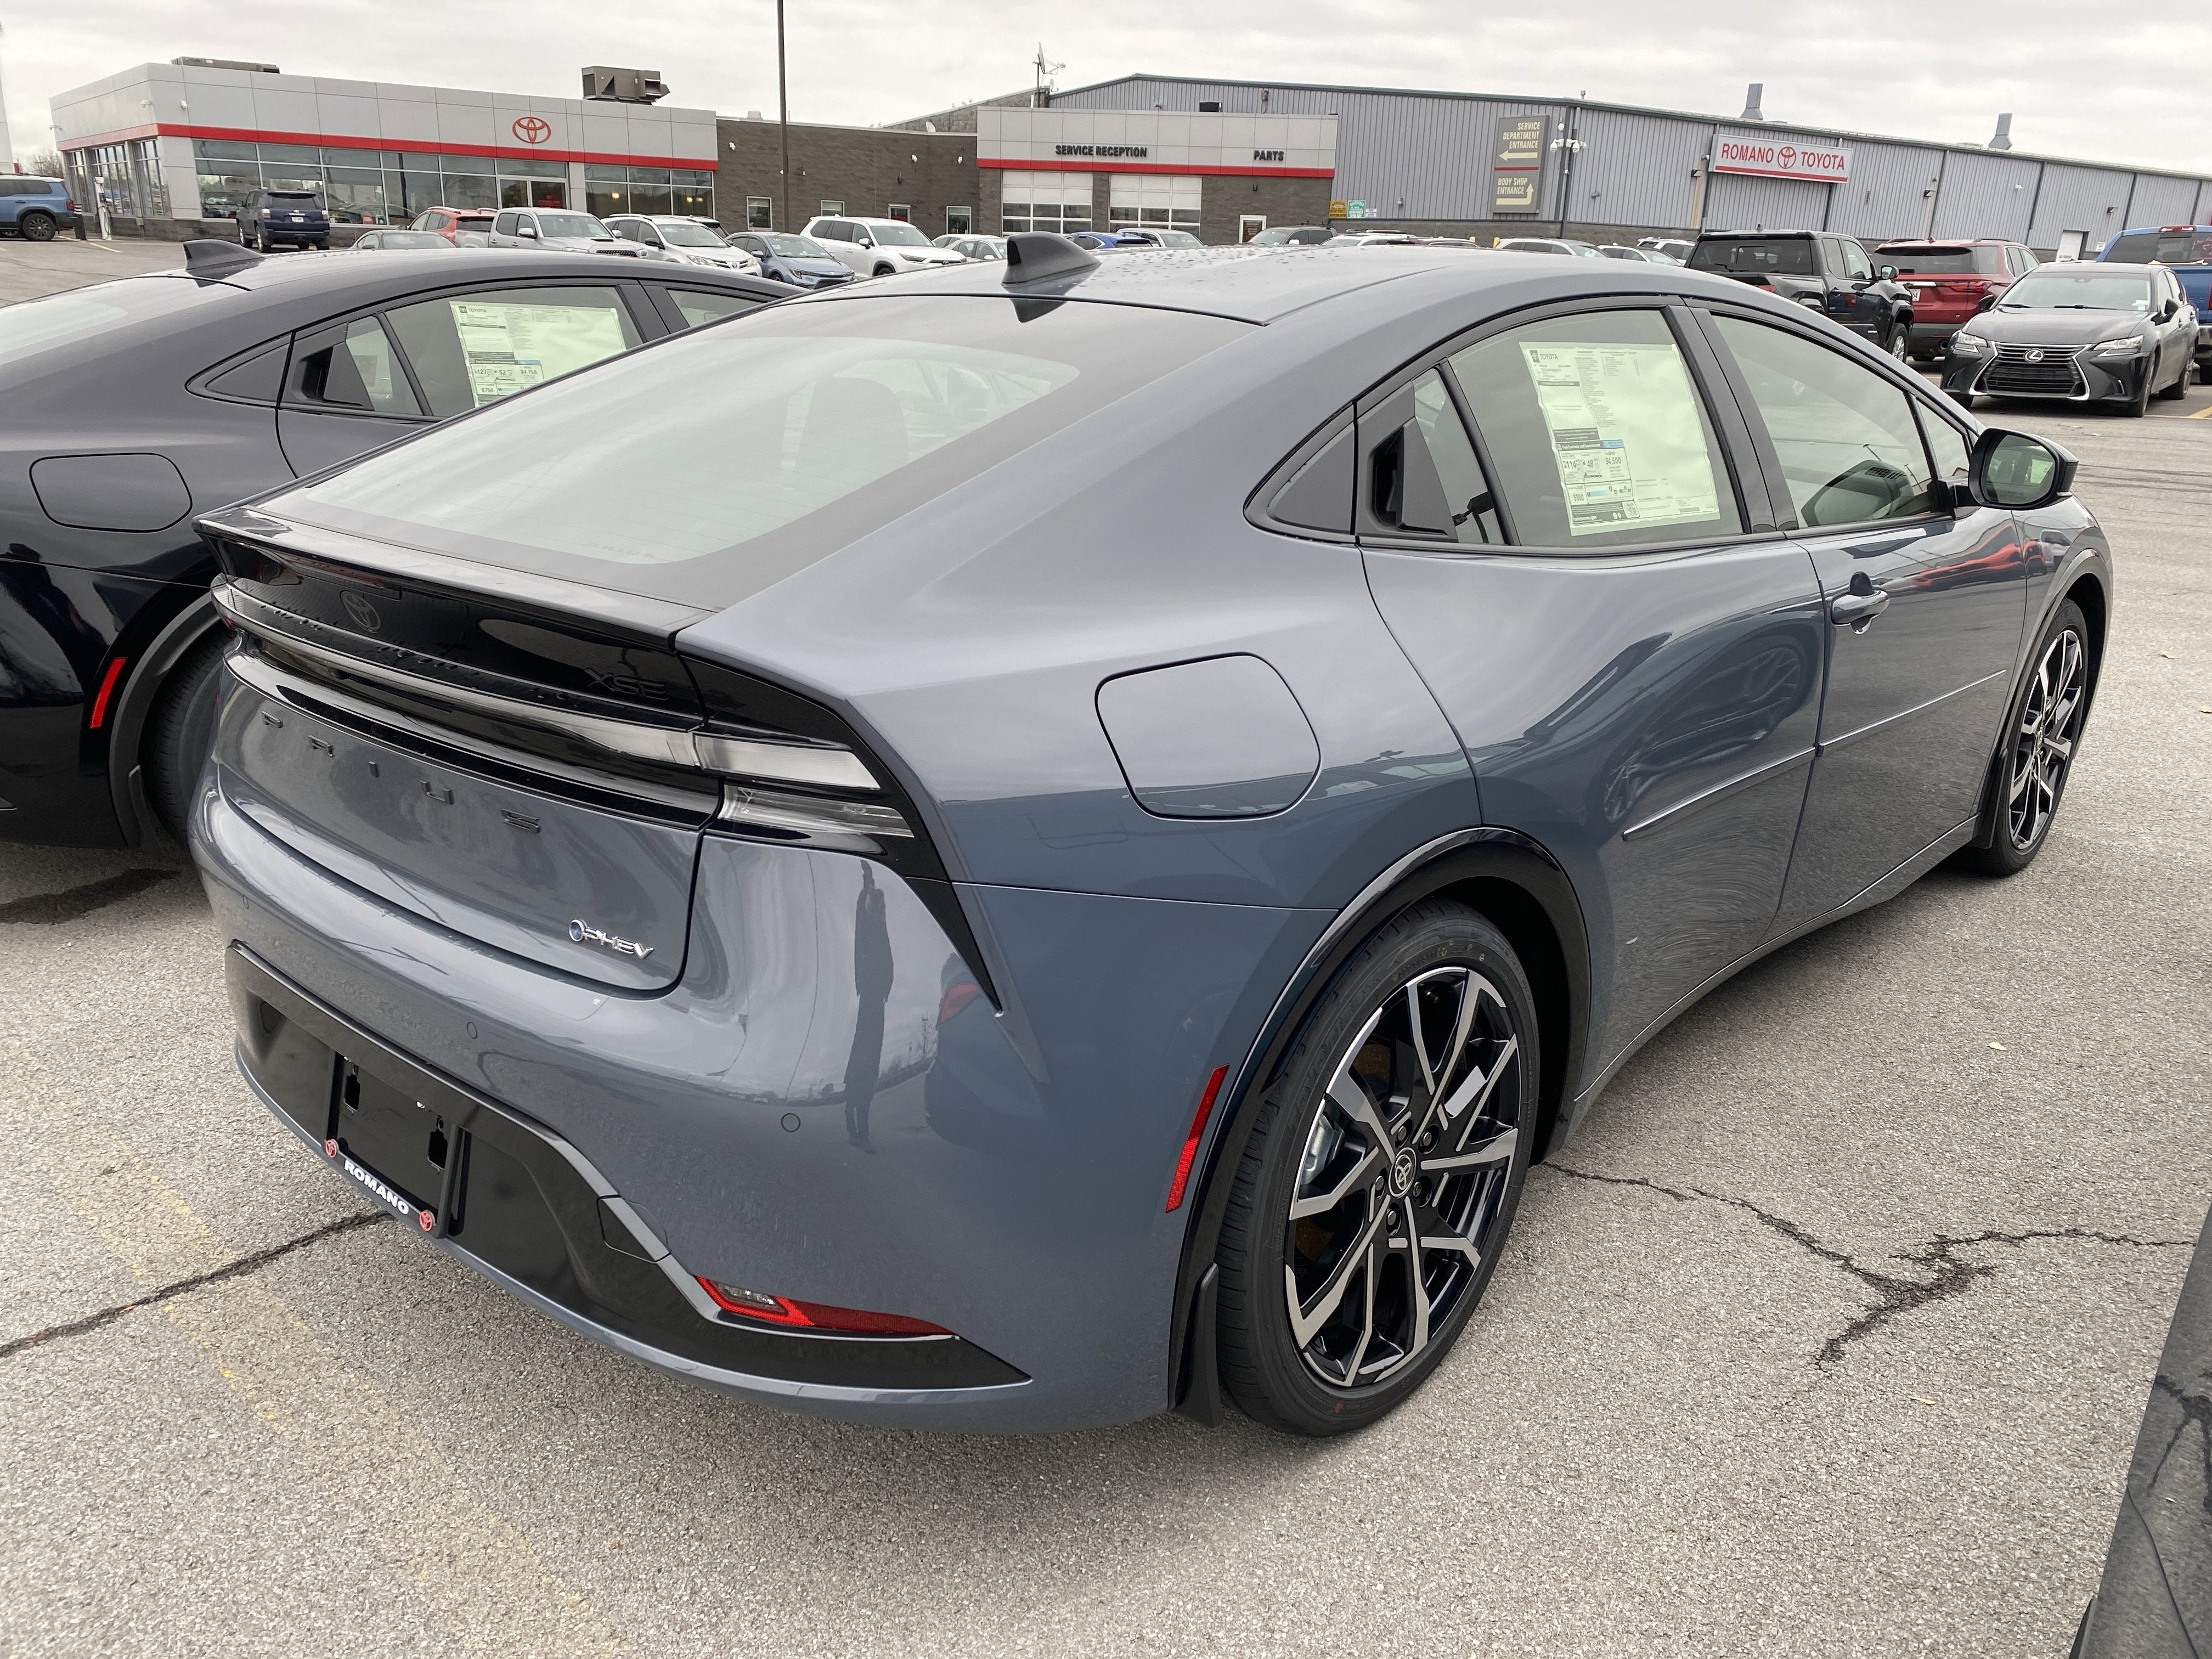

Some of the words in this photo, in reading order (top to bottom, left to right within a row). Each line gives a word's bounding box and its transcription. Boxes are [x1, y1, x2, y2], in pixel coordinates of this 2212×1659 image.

[1517, 122, 1541, 130] SERVICE
[1503, 131, 1540, 140] DEPARTMENT
[1509, 140, 1538, 149] ENTRANCE
[1055, 144, 1093, 156] SERVICE
[1096, 145, 1147, 157] RECEPTION
[1254, 150, 1284, 161] PARTS
[1721, 143, 1774, 163] ROMANO
[1801, 151, 1845, 171] TOYOTA
[1514, 177, 1528, 185] SHOP
[1497, 187, 1525, 195] ENTRANCE
[1566, 460, 1577, 469] 114
[584, 668, 669, 701] XSE
[261, 710, 540, 834] PRIUS
[582, 927, 654, 959] PHEV
[343, 1158, 409, 1215] ROMANO
